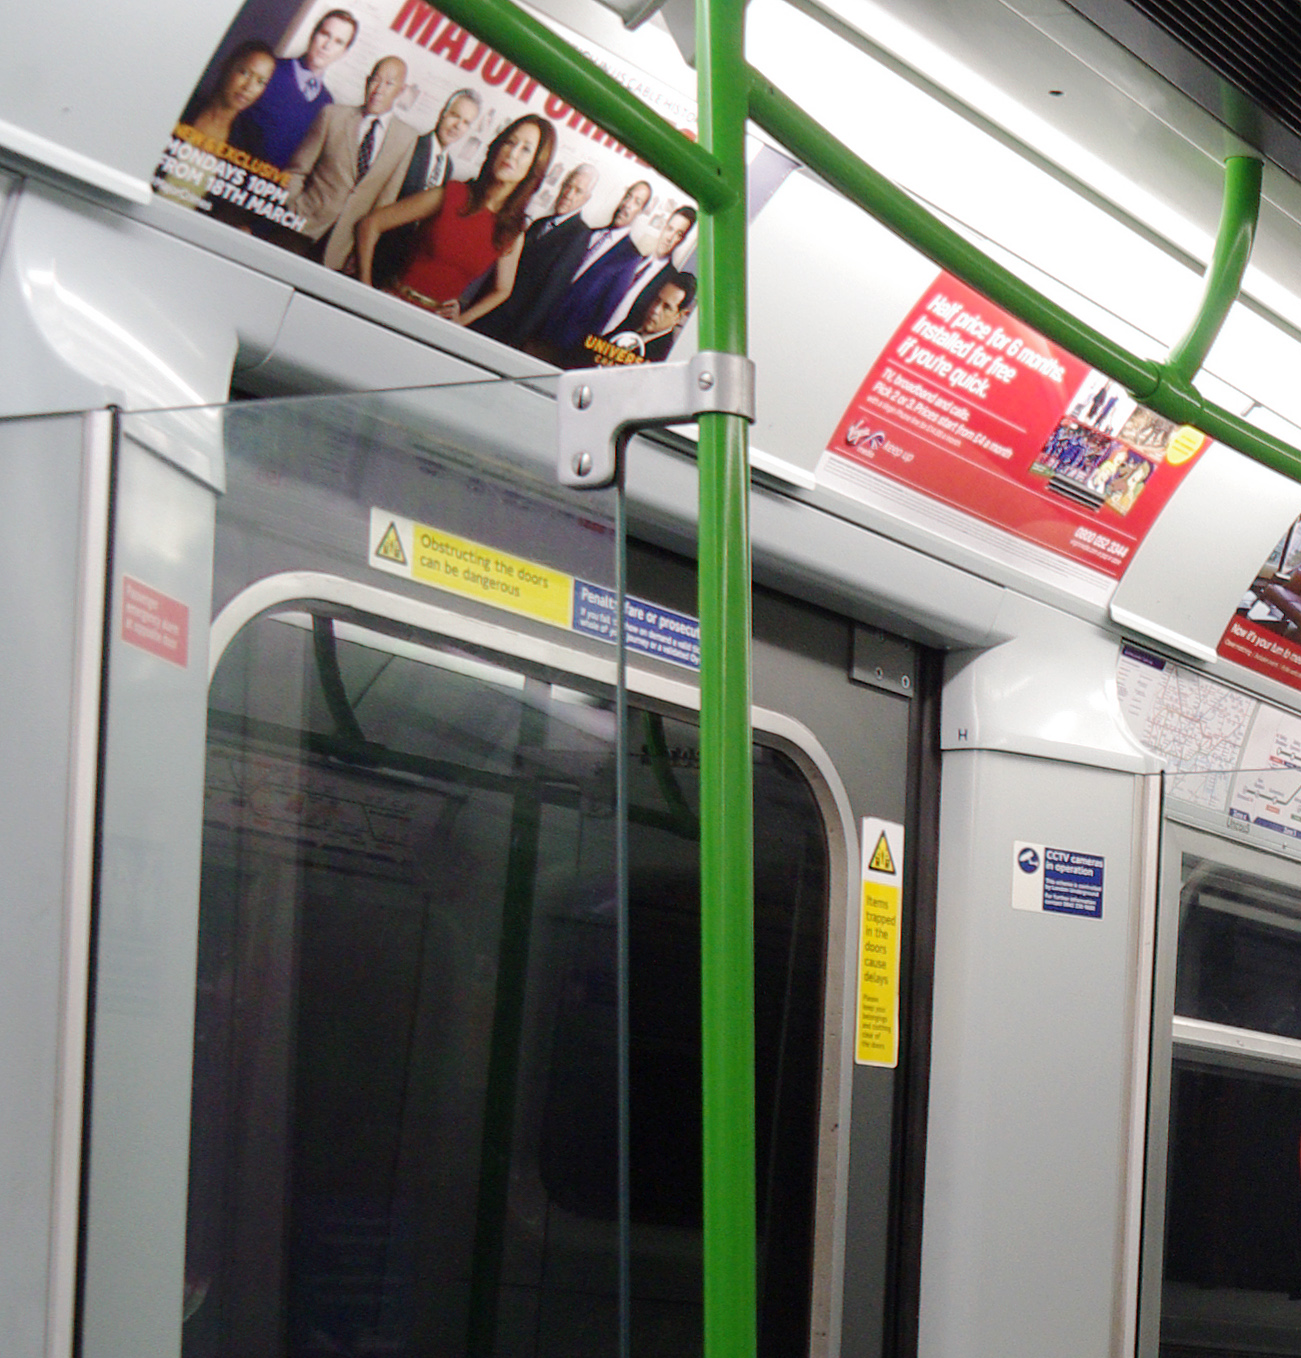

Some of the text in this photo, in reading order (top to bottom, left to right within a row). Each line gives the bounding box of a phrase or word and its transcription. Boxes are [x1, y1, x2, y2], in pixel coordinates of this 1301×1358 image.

[663, 99, 698, 124] HISTO
[168, 138, 247, 186] MONDAYS
[247, 174, 289, 205] 10PM
[217, 142, 291, 188] EXCLUSIVE
[162, 155, 205, 186] FROM
[206, 175, 249, 206] 18TH
[246, 197, 307, 232] MARCH
[927, 293, 960, 322] Half
[953, 310, 991, 342] price
[987, 327, 1013, 351] for
[1006, 338, 1022, 356] 6
[584, 334, 651, 365] UNIVERS
[912, 315, 1018, 383] Installed for free
[896, 337, 993, 398] if you're quick.
[892, 376, 937, 403] broadband
[934, 397, 951, 410] and
[871, 381, 893, 398] Pick
[912, 403, 939, 421] Prices
[937, 416, 958, 431] start
[954, 425, 975, 440] from
[988, 442, 1013, 458] month
[420, 555, 520, 597] can be dangerous
[421, 533, 549, 589] Obstructing the doors
[624, 601, 645, 621] fare
[646, 610, 658, 625] or
[1230, 624, 1247, 637] Now
[1246, 631, 1257, 642] it's
[1255, 637, 1270, 649] your
[1283, 649, 1290, 658] to
[957, 728, 968, 741] H
[1046, 850, 1103, 868] CCTV cameras
[1046, 860, 1094, 877] in operation
[866, 895, 889, 910] Items
[865, 925, 889, 940] in the
[866, 911, 896, 927] trapped
[864, 957, 886, 970] cause
[865, 941, 887, 955] doors
[864, 971, 889, 987] delays
